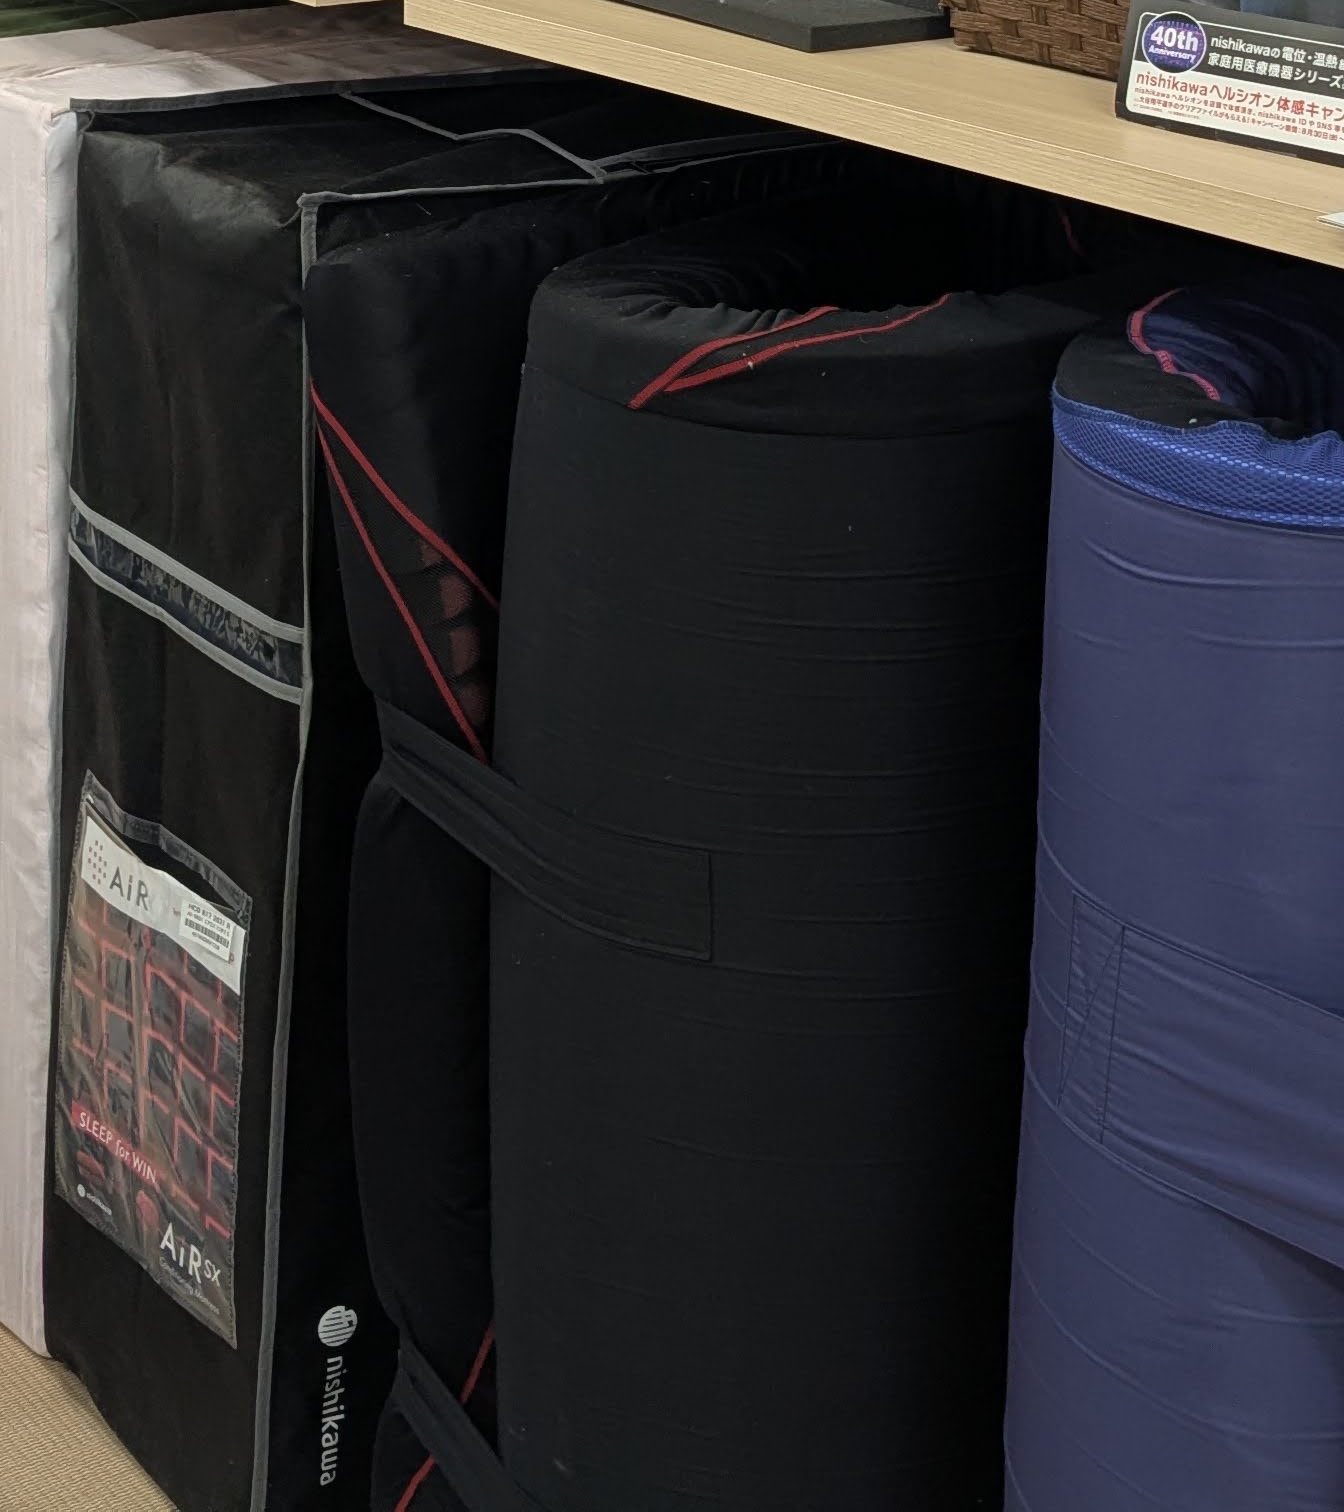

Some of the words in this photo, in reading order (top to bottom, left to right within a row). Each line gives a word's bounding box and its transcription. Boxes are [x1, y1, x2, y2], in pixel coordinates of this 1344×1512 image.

[1148, 44, 1197, 63] Anniversary
[1150, 25, 1199, 52] 40th
[79, 1111, 113, 1144] SLEEP
[115, 1139, 130, 1161] for
[320, 1355, 347, 1486] nishikawa
